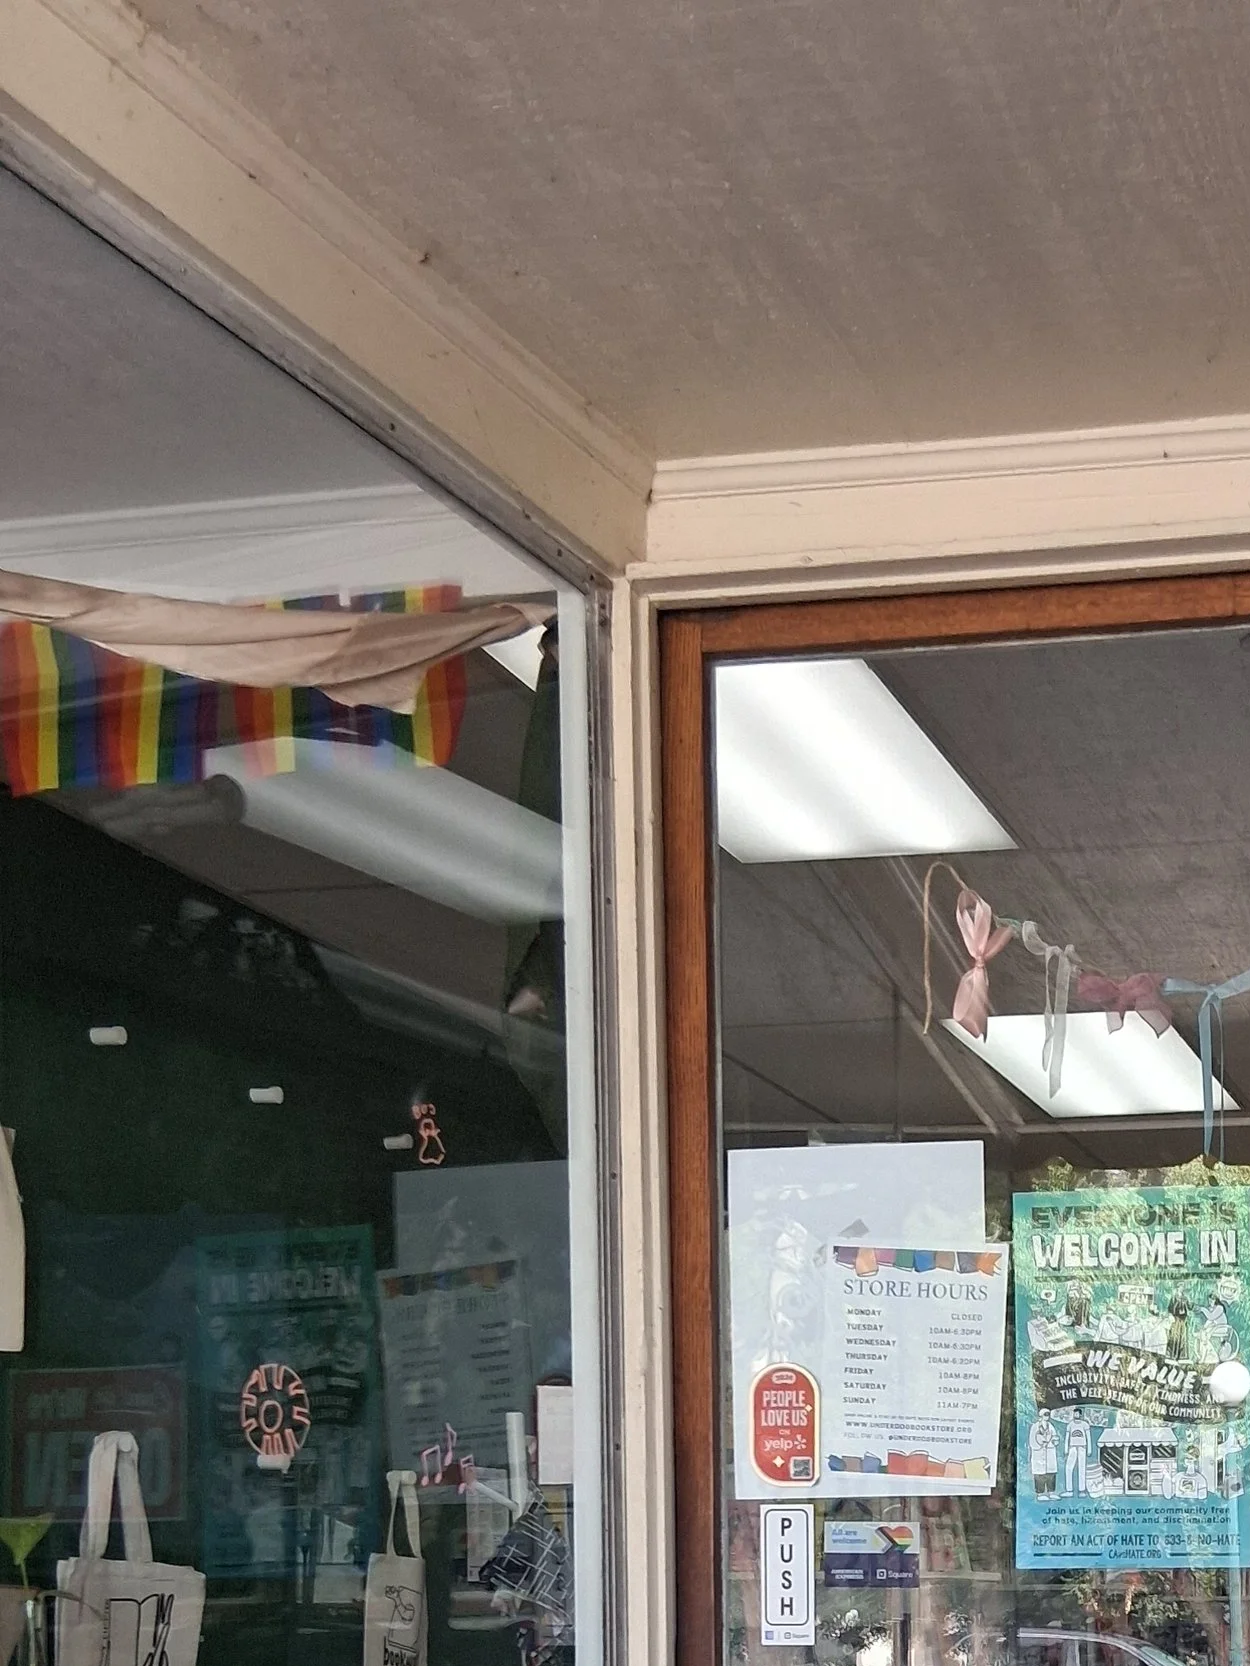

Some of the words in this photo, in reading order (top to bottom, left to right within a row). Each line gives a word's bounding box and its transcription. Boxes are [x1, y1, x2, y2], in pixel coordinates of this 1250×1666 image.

[1031, 1231, 1188, 1270] WELCOME
[1198, 1229, 1239, 1268] IN
[844, 1279, 912, 1298] STORE
[917, 1282, 988, 1301] HOURS
[847, 1308, 882, 1317] MONDAY
[951, 1313, 983, 1322] CLOSED
[846, 1322, 883, 1332] TUESDAY
[845, 1337, 897, 1347] WEDNESDAY
[844, 1352, 888, 1361] THURSDAY
[843, 1367, 874, 1375] FRIDAY
[1086, 1350, 1122, 1371] WE
[1127, 1356, 1198, 1390] VALUE
[843, 1381, 887, 1391] SATURDAY
[762, 1390, 806, 1408] PEOPLE
[843, 1396, 876, 1405] SUNDAY
[1060, 1389, 1077, 1401] THE
[760, 1409, 791, 1427] LOVE
[791, 1409, 808, 1427] US
[763, 1437, 793, 1452] yelp
[1045, 1506, 1067, 1516] Join
[1068, 1507, 1080, 1516] us
[1082, 1506, 1092, 1515] in
[1093, 1506, 1132, 1518] keeping
[1135, 1507, 1151, 1516] our
[1154, 1506, 1208, 1518] community
[1042, 1515, 1055, 1525] of
[1141, 1515, 1159, 1525] and
[1032, 1534, 1069, 1547] REPORT
[1070, 1534, 1085, 1546] AN
[1086, 1534, 1105, 1547] ACT
[1106, 1534, 1120, 1546] OF
[1120, 1534, 1145, 1546] HATE
[1147, 1534, 1160, 1546] TO
[780, 1517, 794, 1617] PUSH
[887, 1570, 914, 1580] Square
